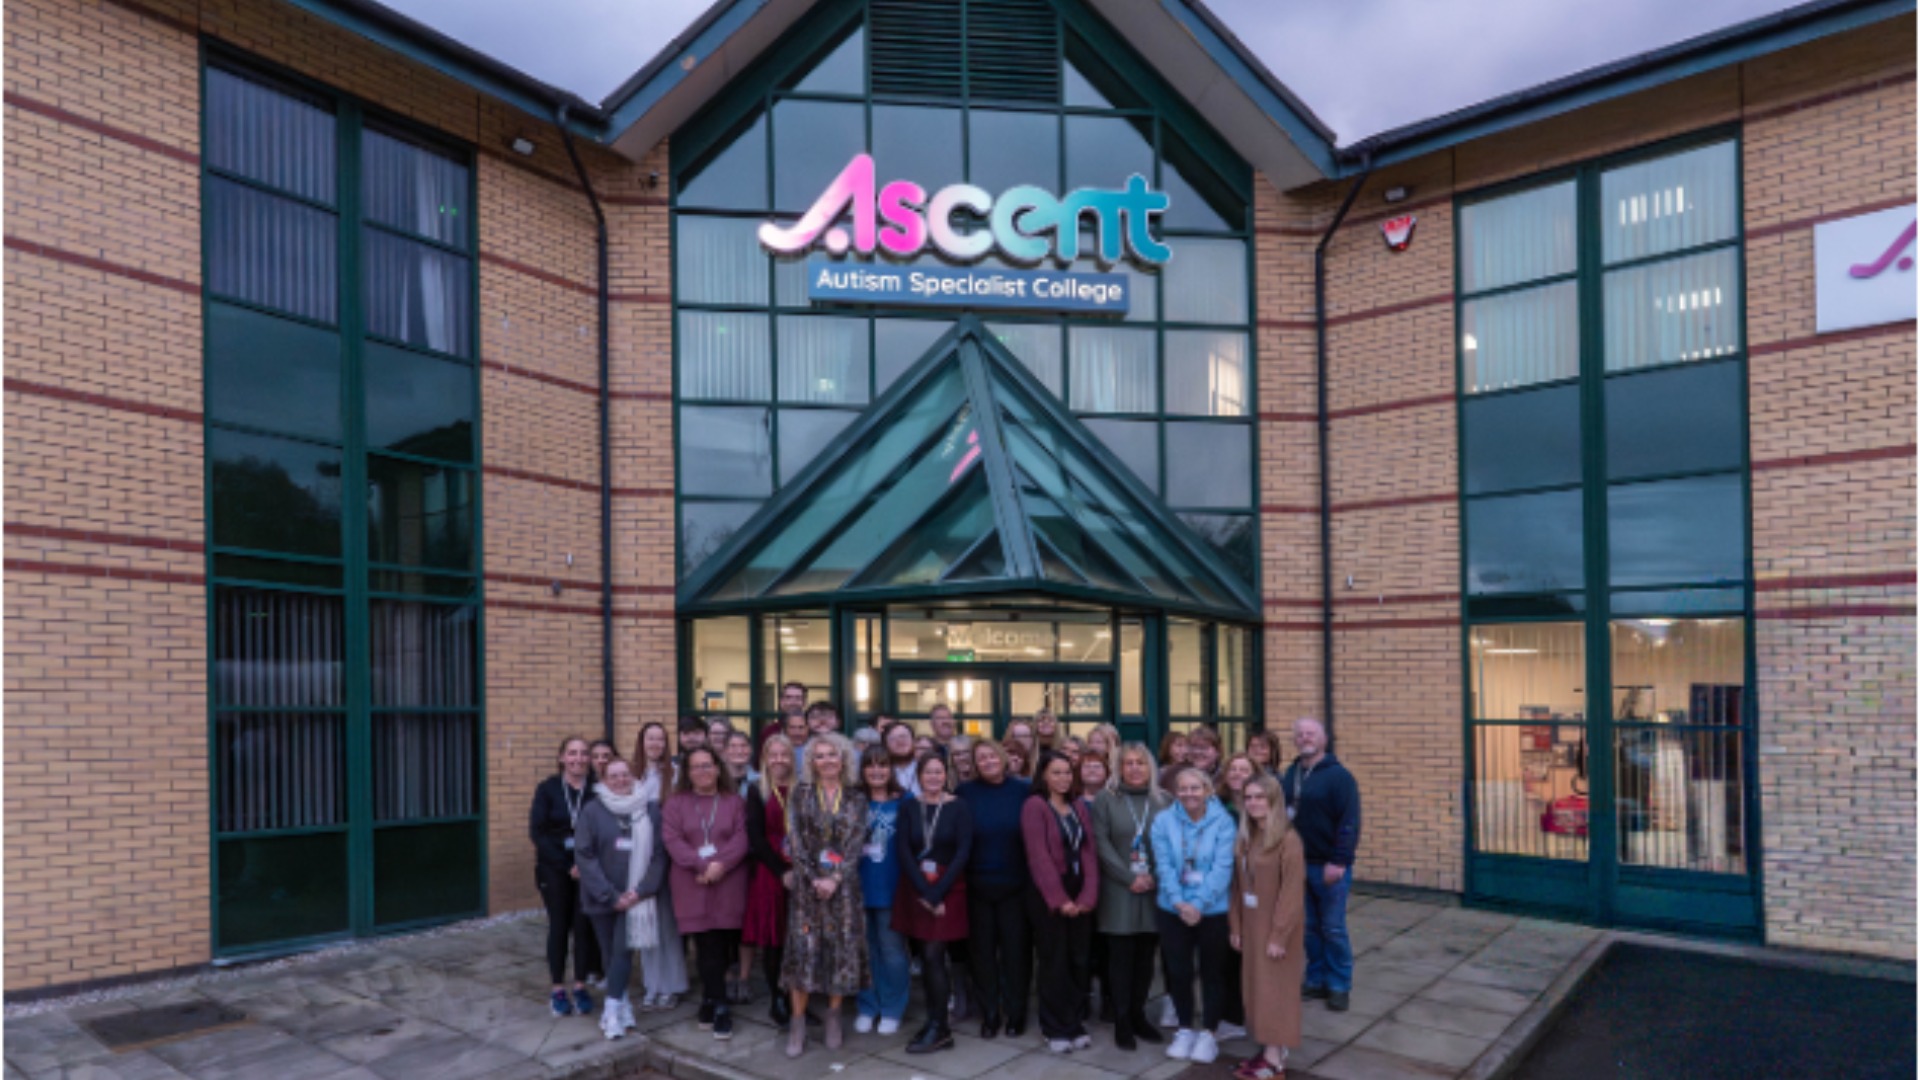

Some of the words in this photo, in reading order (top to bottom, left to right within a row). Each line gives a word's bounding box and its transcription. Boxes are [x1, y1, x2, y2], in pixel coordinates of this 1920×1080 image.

[758, 153, 1172, 263] Ascent
[816, 268, 901, 293] Autism
[909, 271, 1026, 299] Specialist
[1032, 277, 1122, 304] College
